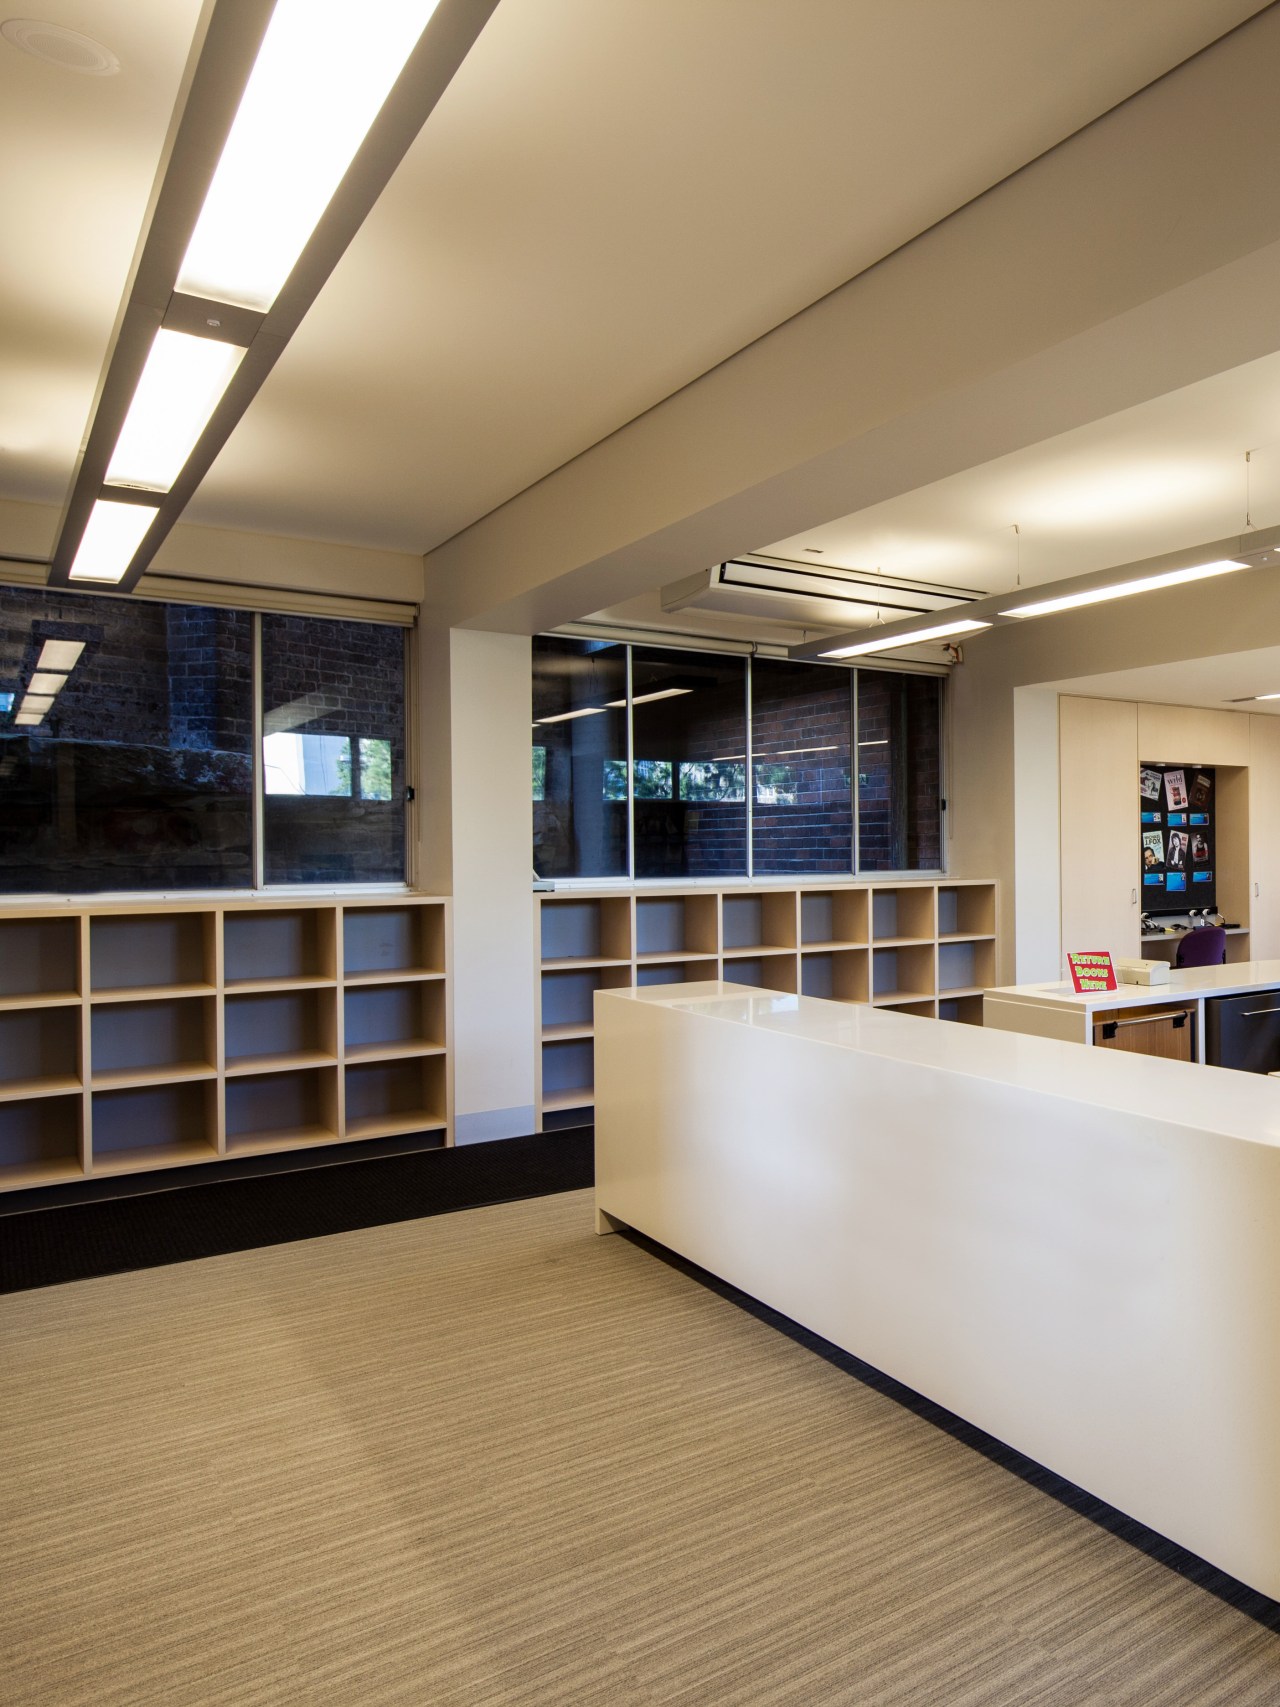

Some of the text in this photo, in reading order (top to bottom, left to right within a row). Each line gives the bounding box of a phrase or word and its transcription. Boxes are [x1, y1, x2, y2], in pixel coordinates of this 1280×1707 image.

[1071, 954, 1110, 965] RETURN
[1075, 966, 1108, 977] BOOKS
[1080, 979, 1107, 990] HERE
